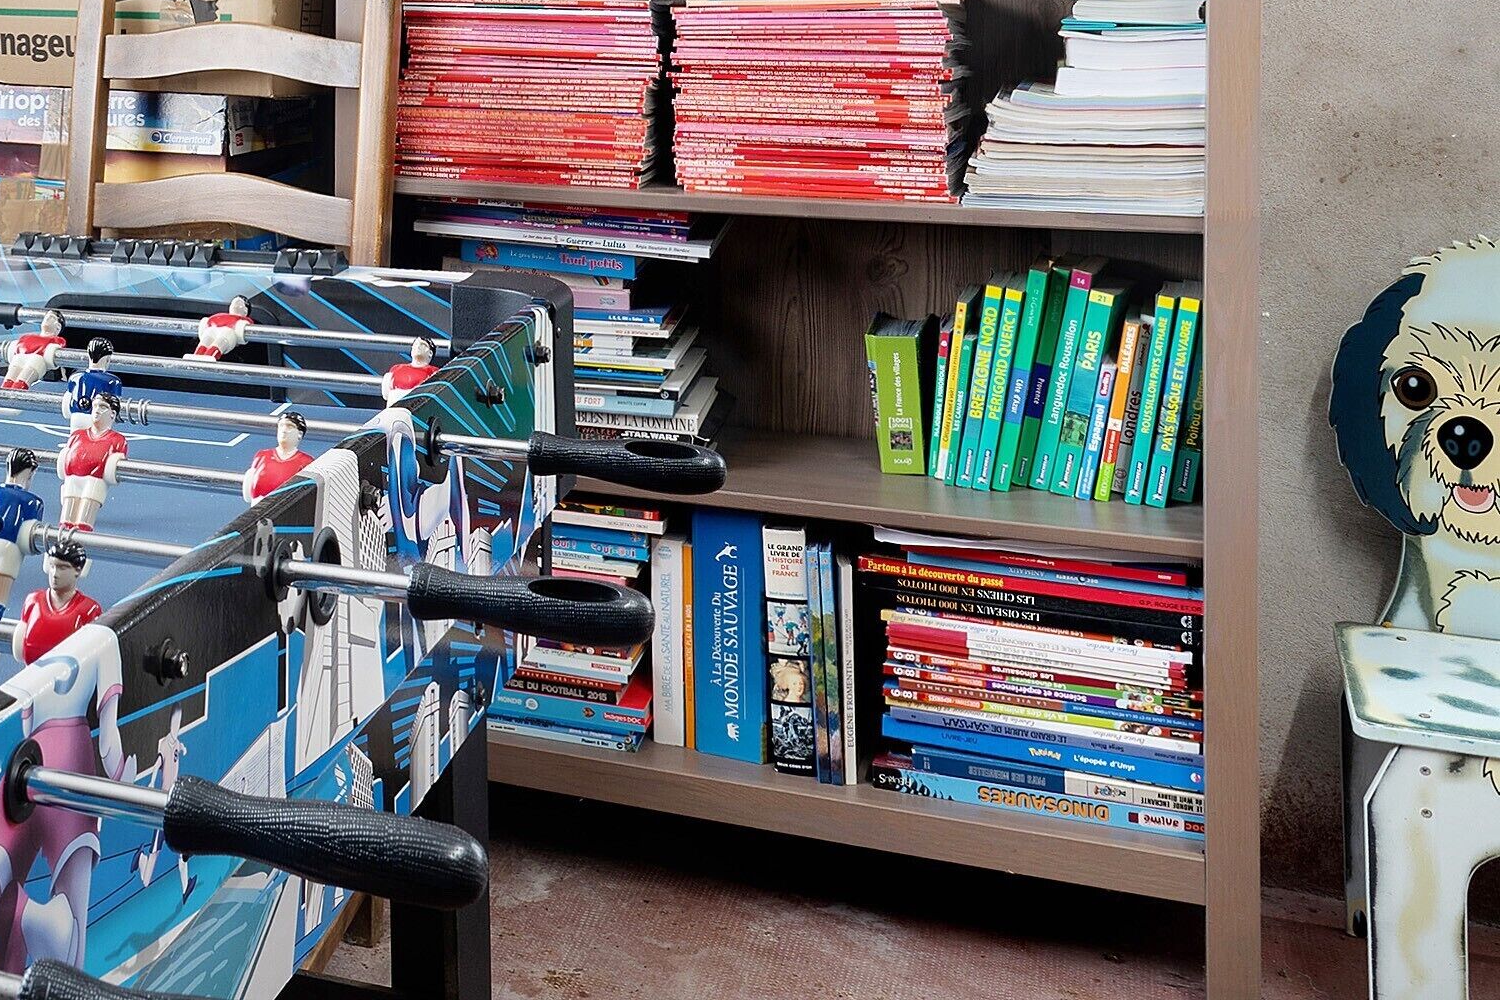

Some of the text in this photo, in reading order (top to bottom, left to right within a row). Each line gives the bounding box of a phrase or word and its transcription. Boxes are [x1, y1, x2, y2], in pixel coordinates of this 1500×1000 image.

[18, 115, 41, 126] des
[566, 236, 627, 249] Guerre Lulus
[891, 352, 902, 375] villages
[969, 306, 998, 419] BRETAGNE NORD
[1081, 330, 1102, 370] PARIS
[1119, 326, 1137, 374] BALÉARES
[985, 308, 1017, 421] PÉRIGORD QUERCY
[1047, 371, 1069, 425] Languedoc
[1058, 319, 1079, 370] Roussillon
[1140, 316, 1168, 434] ROUSSILLON PAYS CATHARE
[893, 376, 902, 386] des
[1033, 377, 1045, 404] Provence
[1160, 320, 1193, 452] PAYS BASQUE ET NAVARRE
[893, 388, 902, 408] France
[954, 390, 964, 419] CANARIES
[1011, 378, 1024, 414] Côte d'Azur
[1088, 403, 1106, 452] Espagnol
[1119, 390, 1142, 447] Londres
[1185, 413, 1202, 446] Poitou
[620, 430, 680, 441] STAR WARS
[1131, 461, 1143, 489] MICHELIN
[1155, 465, 1168, 493] MICHELIN
[1180, 459, 1192, 487] MICHELIN
[777, 543, 803, 551] GRAND
[867, 560, 1004, 587] Partons à la découverte du passé
[1008, 567, 1045, 577] ANIMAUX
[660, 572, 672, 612] NATUREL
[897, 578, 1035, 606] LES CHIENS EN 1000 PHOTOS
[896, 594, 1040, 622] LES OISEAUX EN 1000 PHOTOS
[660, 623, 671, 655] SANTÉ
[710, 592, 722, 686] À La Découverte Du
[722, 564, 740, 719] MONDE SAUVAGE
[662, 656, 671, 665] LA
[662, 665, 671, 675] DE
[991, 666, 1055, 681] Les dinosaures
[521, 670, 550, 680] PRIVÉE
[571, 677, 605, 688] HOMMES
[527, 681, 539, 690] DU
[541, 683, 584, 698] FOOTBALL
[587, 690, 607, 701] 2015
[660, 675, 672, 698] BIBLE
[991, 682, 1088, 703] Science et expériences
[663, 699, 673, 713] MA
[845, 659, 854, 748] EUGÈNE FROMENTIN
[941, 717, 1067, 743] LE GRAND ALBUM DE SAMSAM
[1073, 754, 1107, 768] L'épopée
[1110, 758, 1136, 772] d'Unys
[977, 783, 1111, 824] DINOSAURES
